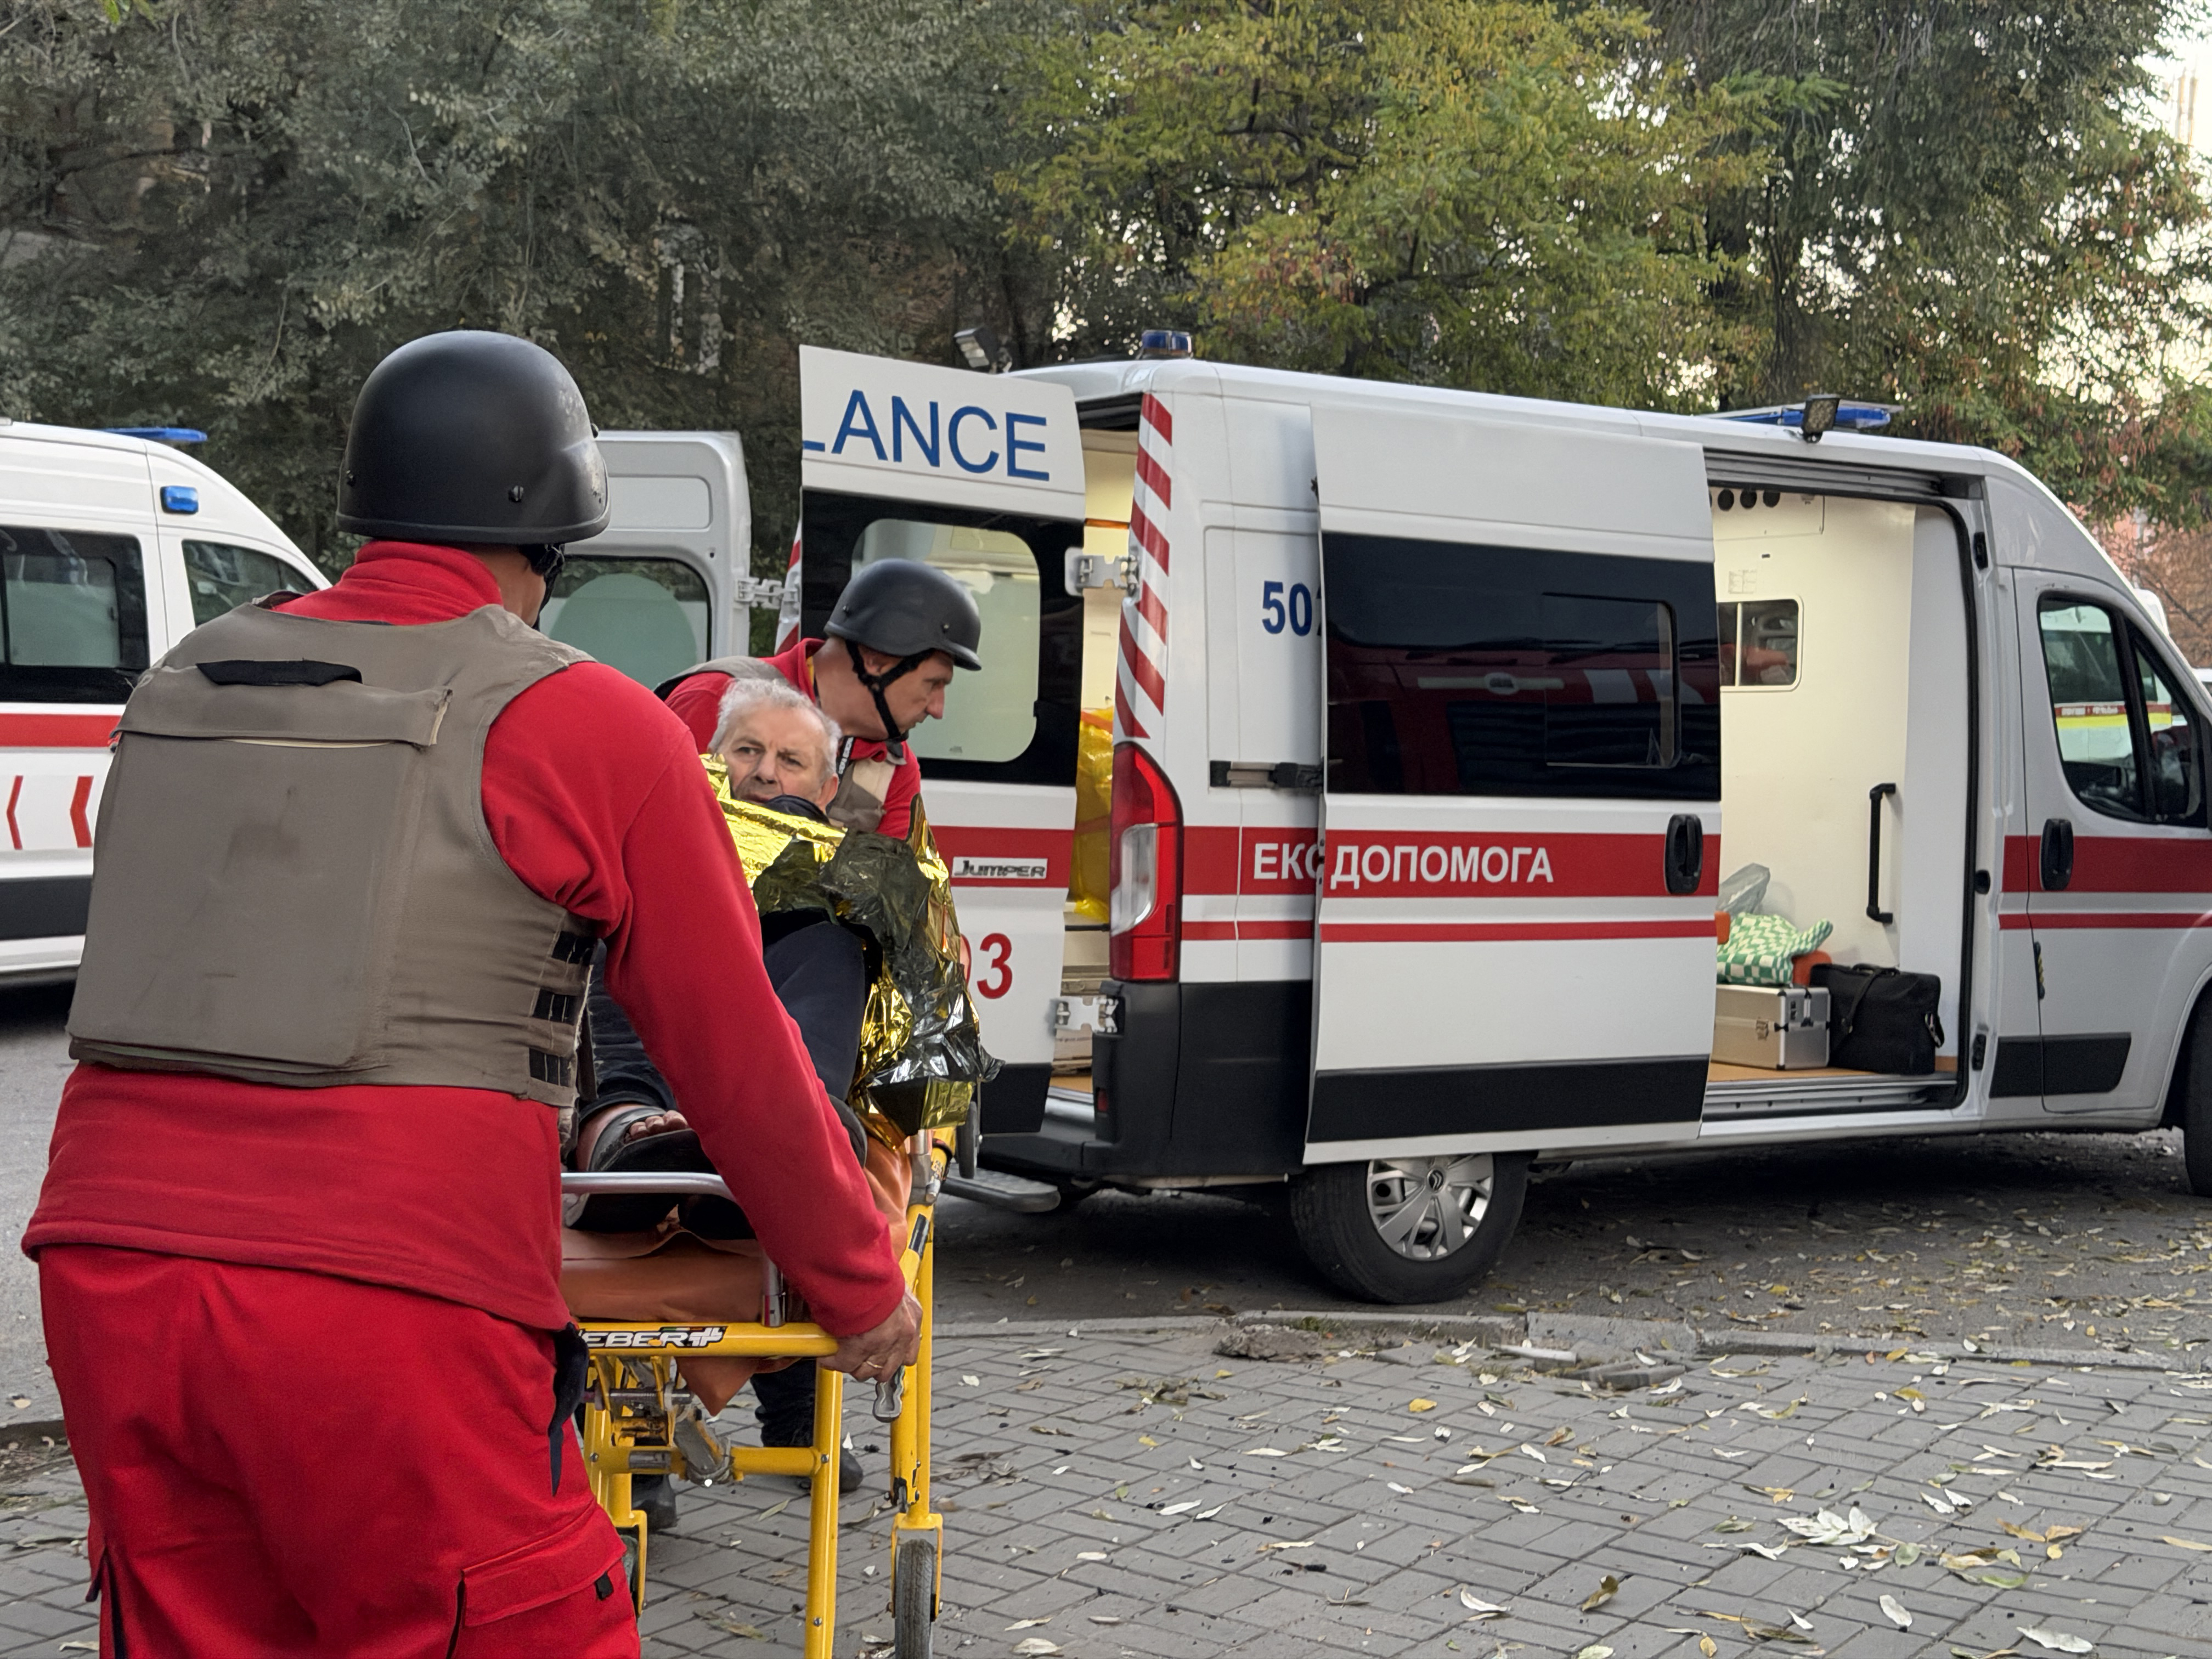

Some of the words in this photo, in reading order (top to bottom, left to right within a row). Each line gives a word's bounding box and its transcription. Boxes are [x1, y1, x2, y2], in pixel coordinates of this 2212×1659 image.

[1262, 580, 1322, 637] 50
[1330, 845, 1554, 890] ДОПОМОГА
[578, 1329, 689, 1347] EBER
